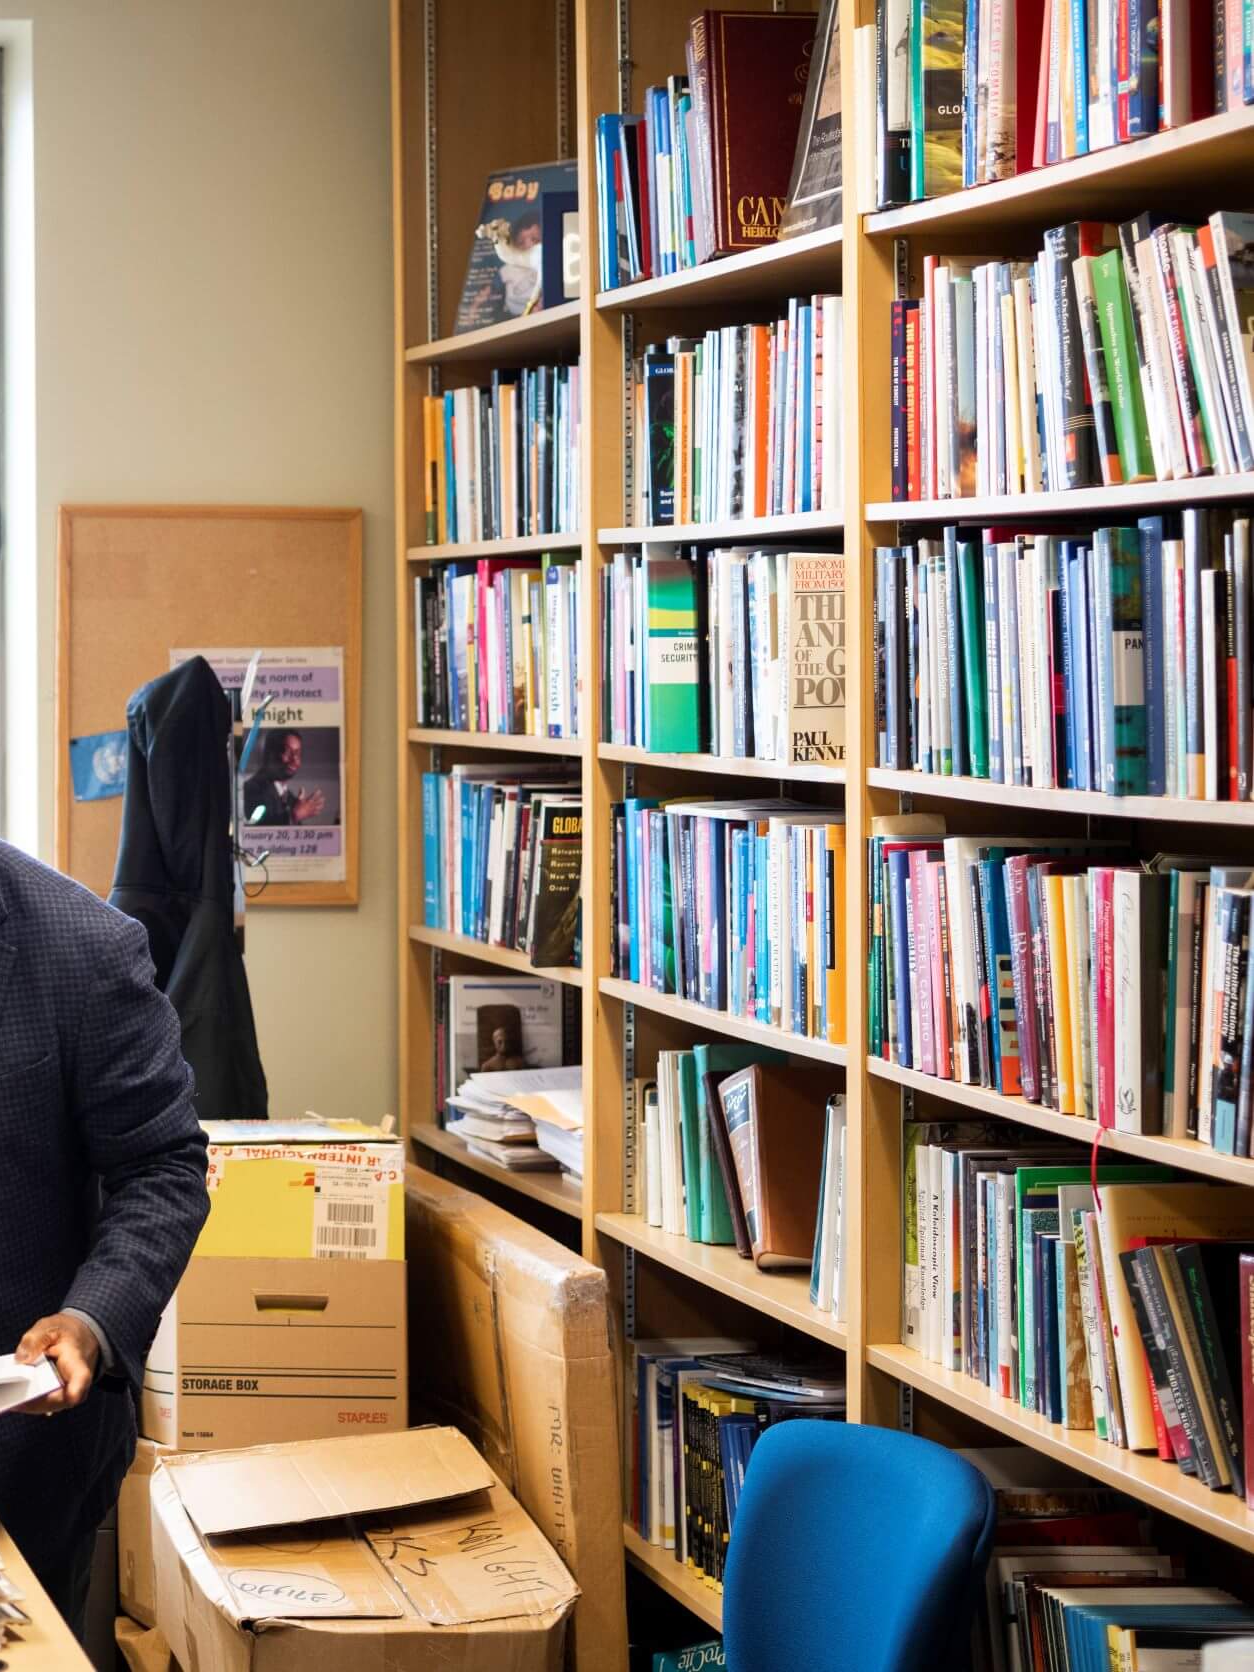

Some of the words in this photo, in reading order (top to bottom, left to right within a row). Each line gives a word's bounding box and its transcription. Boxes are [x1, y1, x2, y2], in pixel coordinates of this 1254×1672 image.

[1217, 0, 1227, 77] UCKER
[488, 179, 540, 203] Baby
[742, 226, 780, 238] HEIRLO
[1060, 276, 1068, 297] The
[1061, 299, 1070, 333] Oxford
[906, 322, 914, 343] THE
[1171, 320, 1183, 352] FIGHT
[906, 345, 914, 367] END
[1062, 335, 1072, 387] Handbook
[1106, 303, 1118, 347] Approaches
[1112, 359, 1122, 383] World
[1117, 384, 1125, 408] Order
[795, 571, 844, 580] MILITARY
[795, 580, 825, 589] FROM
[795, 650, 813, 662] OF
[938, 630, 947, 659] United
[269, 675, 298, 683] norm
[302, 672, 313, 683] of
[795, 664, 824, 676] THE
[940, 661, 948, 698] Nations
[282, 688, 322, 698] Protect
[792, 730, 831, 747] PAUL
[1103, 900, 1112, 940] Drapeau
[917, 922, 928, 974] FIDEL
[1232, 945, 1240, 964] The
[1191, 969, 1199, 1003] European
[1231, 966, 1239, 1001] United
[919, 978, 930, 1042] CASTRO
[1228, 1001, 1237, 1044] Nations,
[918, 1189, 926, 1221] Applied
[182, 1378, 233, 1390] STORAGE
[236, 1379, 258, 1391] BOX
[338, 1411, 388, 1424] STAPLES
[1166, 1368, 1184, 1410] ENDLESS
[1177, 1412, 1193, 1441] NIGHT
